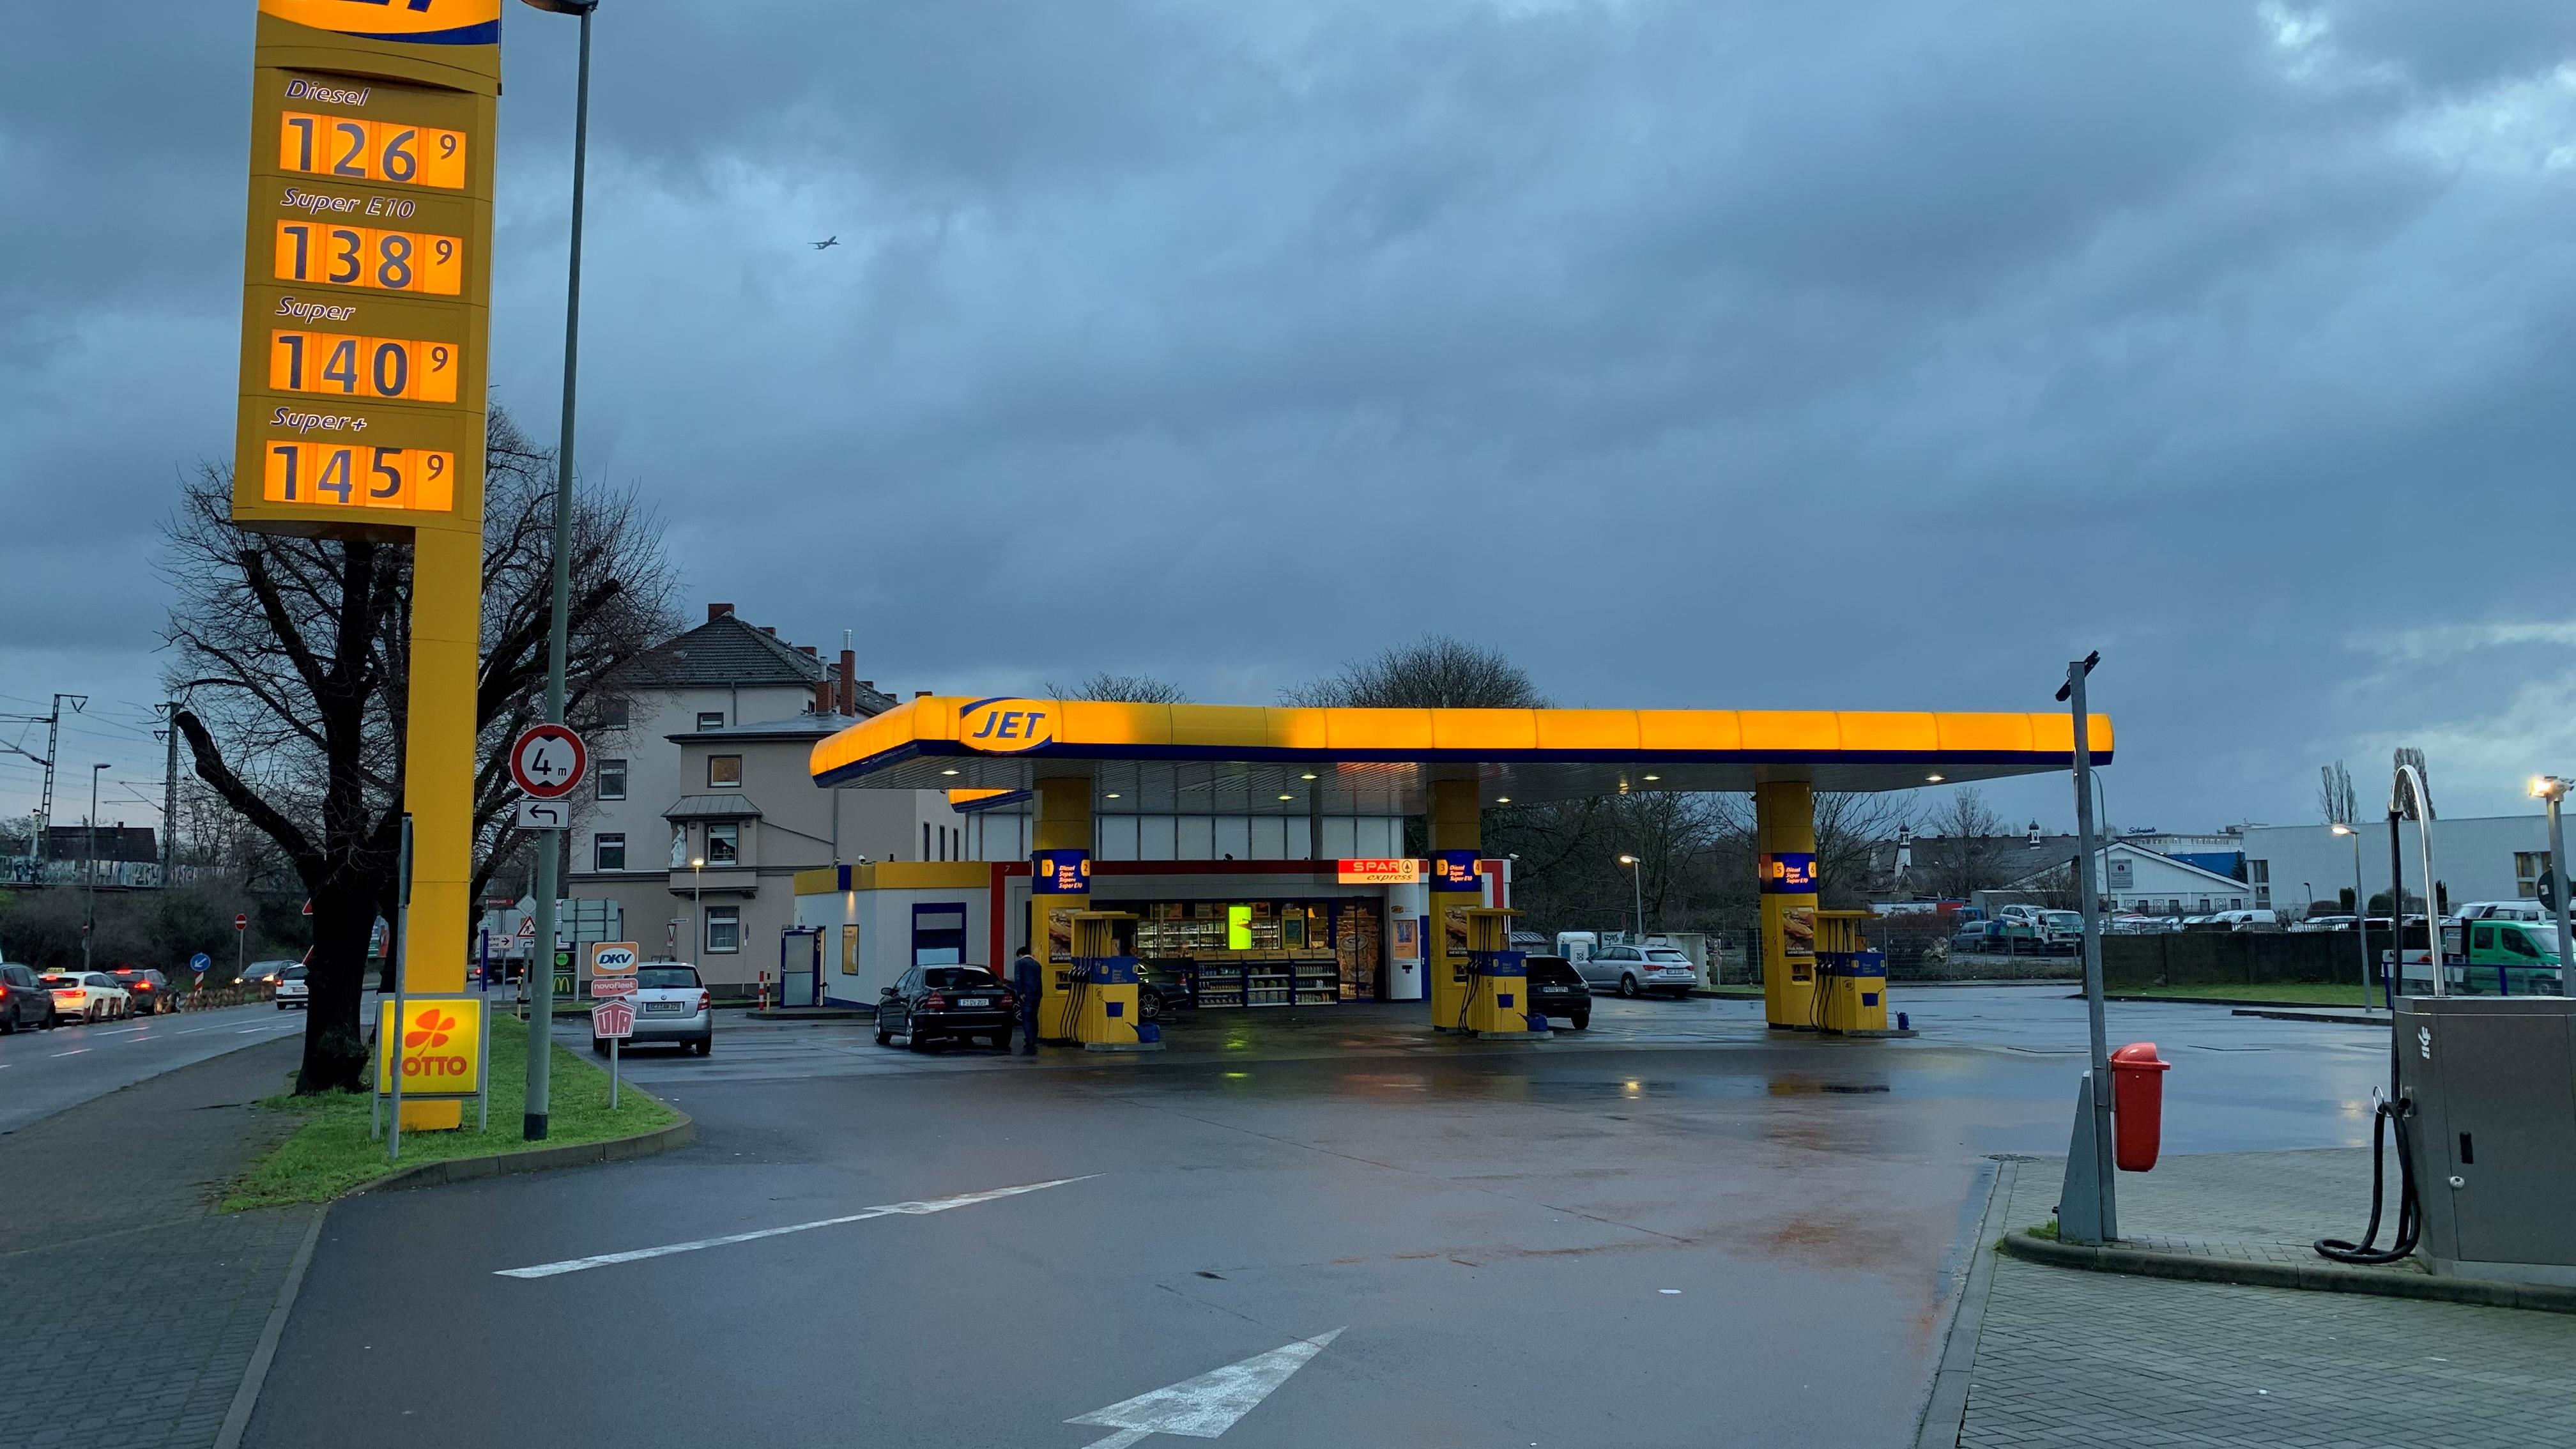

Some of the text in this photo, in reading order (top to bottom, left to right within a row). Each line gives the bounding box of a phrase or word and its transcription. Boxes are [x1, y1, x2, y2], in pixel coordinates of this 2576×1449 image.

[285, 79, 371, 107] Diesel
[280, 188, 415, 218] Super E10
[275, 296, 355, 323] Super
[270, 406, 367, 434] Super+
[972, 711, 1046, 738] JET
[1046, 864, 1050, 872] 1
[1084, 863, 1088, 871] 2
[1353, 862, 1399, 871] SPAR
[599, 953, 632, 964] DKV
[594, 981, 633, 990] novofleet
[597, 1004, 632, 1034] UTA
